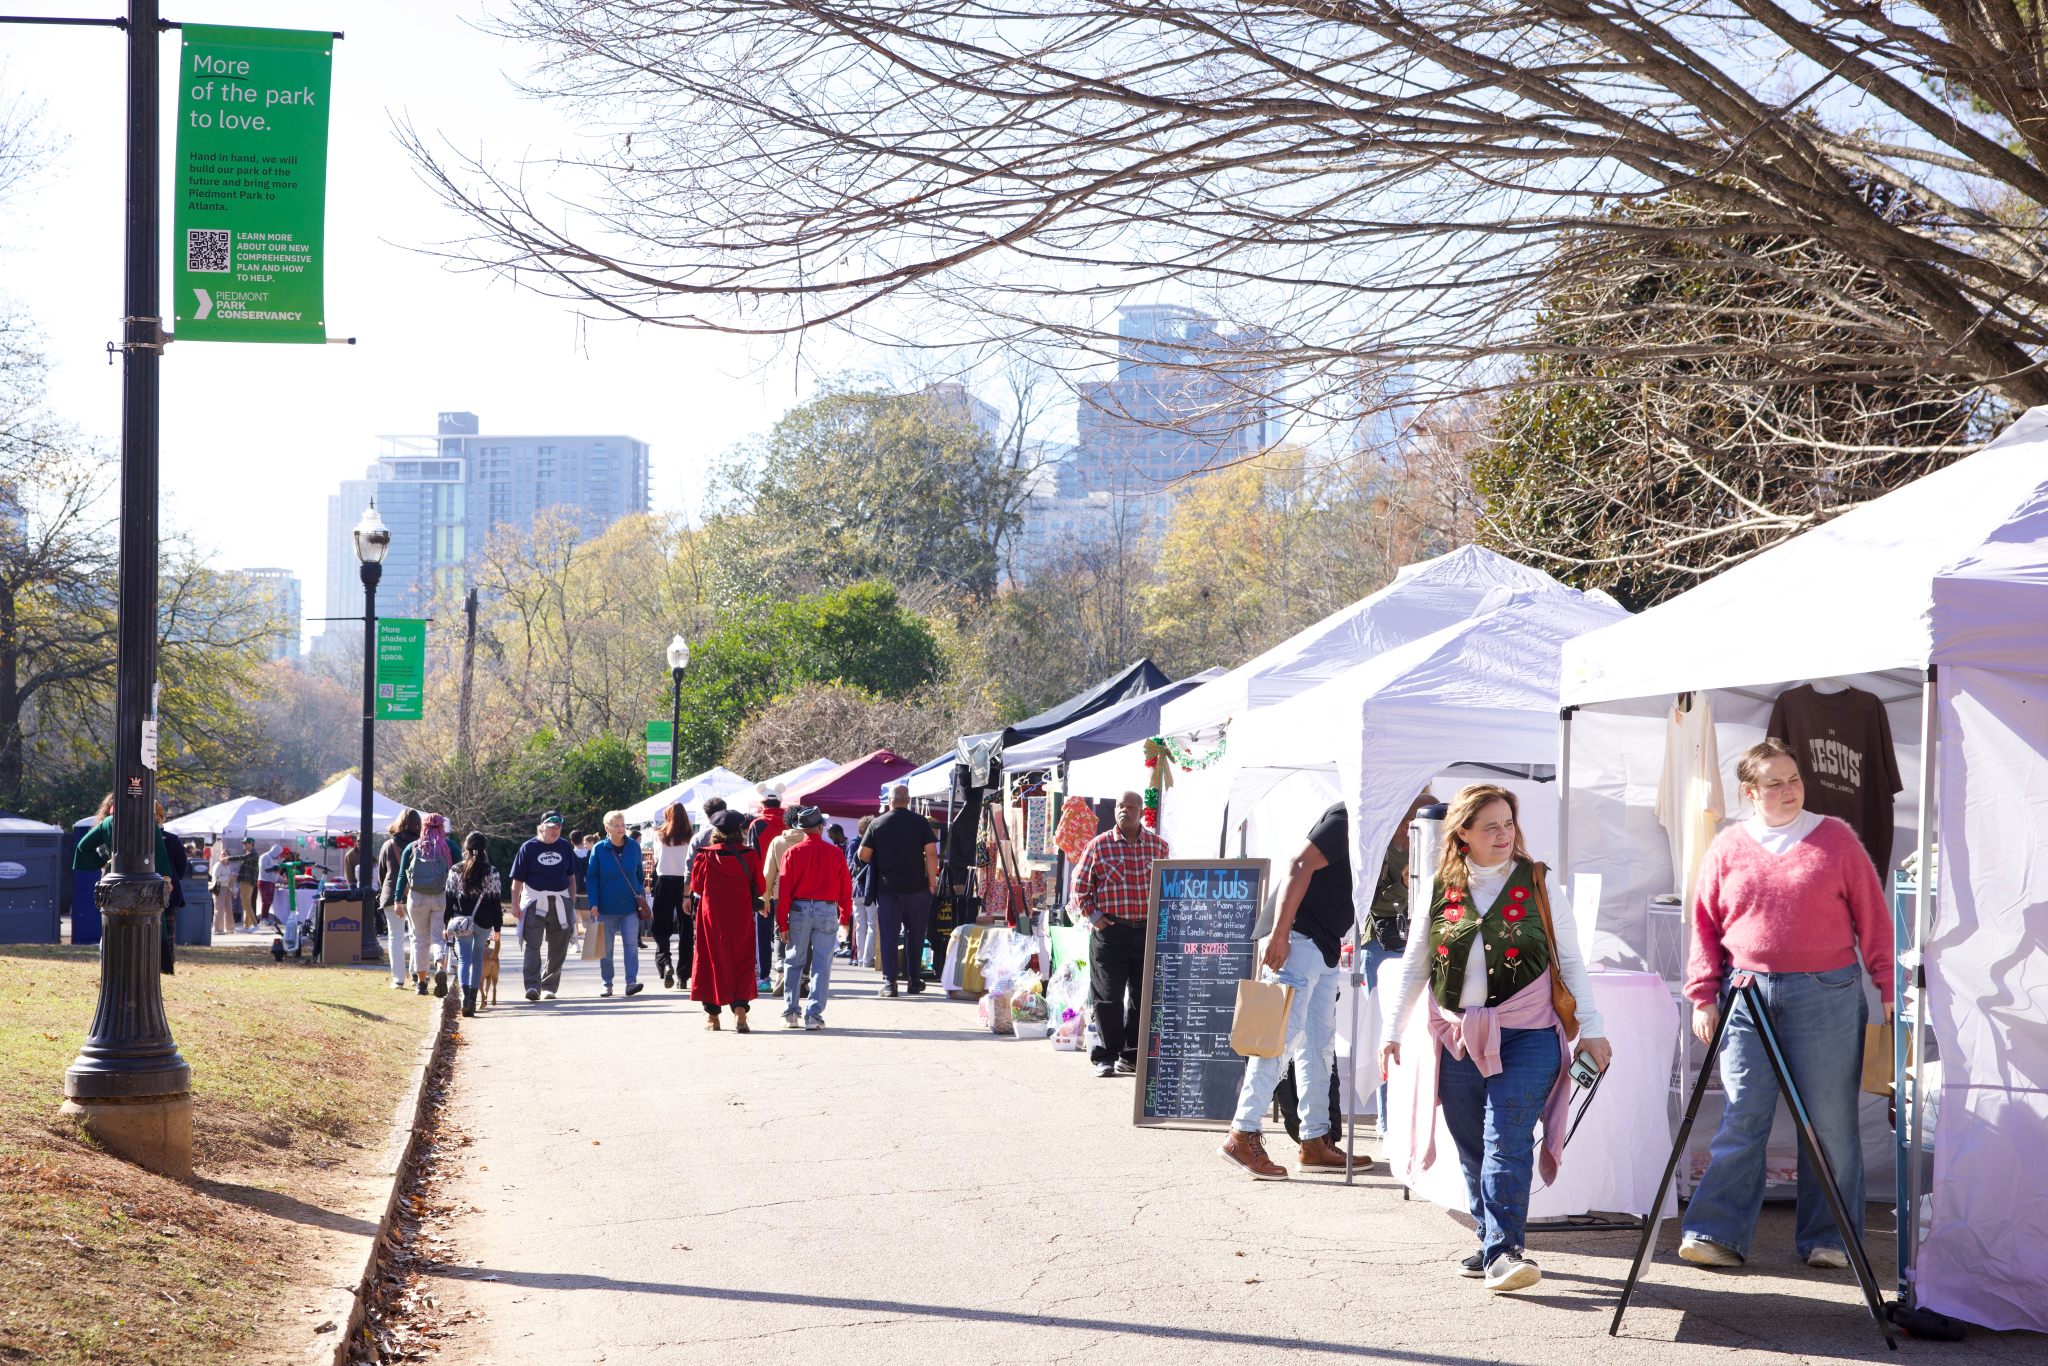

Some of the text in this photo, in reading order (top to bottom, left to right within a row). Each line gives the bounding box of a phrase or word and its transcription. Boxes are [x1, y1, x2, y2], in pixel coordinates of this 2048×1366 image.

[194, 55, 250, 75] More
[191, 81, 315, 108] of the park
[190, 109, 271, 131] to love.
[190, 152, 216, 161] Hand
[219, 153, 228, 162] in
[231, 153, 259, 164] hand,
[279, 155, 298, 164] will
[189, 164, 215, 174] build
[236, 166, 259, 177] park
[262, 167, 272, 176] of
[274, 167, 291, 176] the
[189, 176, 298, 190] future and bring more
[188, 189, 276, 200] Piedmont Park to
[188, 201, 229, 211] Atlanta.
[237, 232, 293, 242] LEARN MORE
[236, 242, 267, 251] ABOUT
[268, 244, 287, 252] OUR
[236, 253, 312, 263] COMPREHENSIVE
[236, 263, 304, 273] PLAN AND HOW
[236, 274, 275, 282] TO HELP.
[216, 291, 269, 302] PIEDMONT
[216, 301, 246, 310] PARK
[216, 310, 302, 321] CONSERVANCY
[381, 626, 400, 634] More
[381, 635, 417, 643] shades of
[380, 645, 402, 653] green
[380, 653, 404, 661] space.
[1828, 728, 1836, 736] IN
[1236, 902, 1254, 914] Spray
[1195, 912, 1212, 920] Candle
[1217, 911, 1233, 921] Body
[330, 922, 357, 930] LOWE'S
[1187, 926, 1205, 936] Candle
